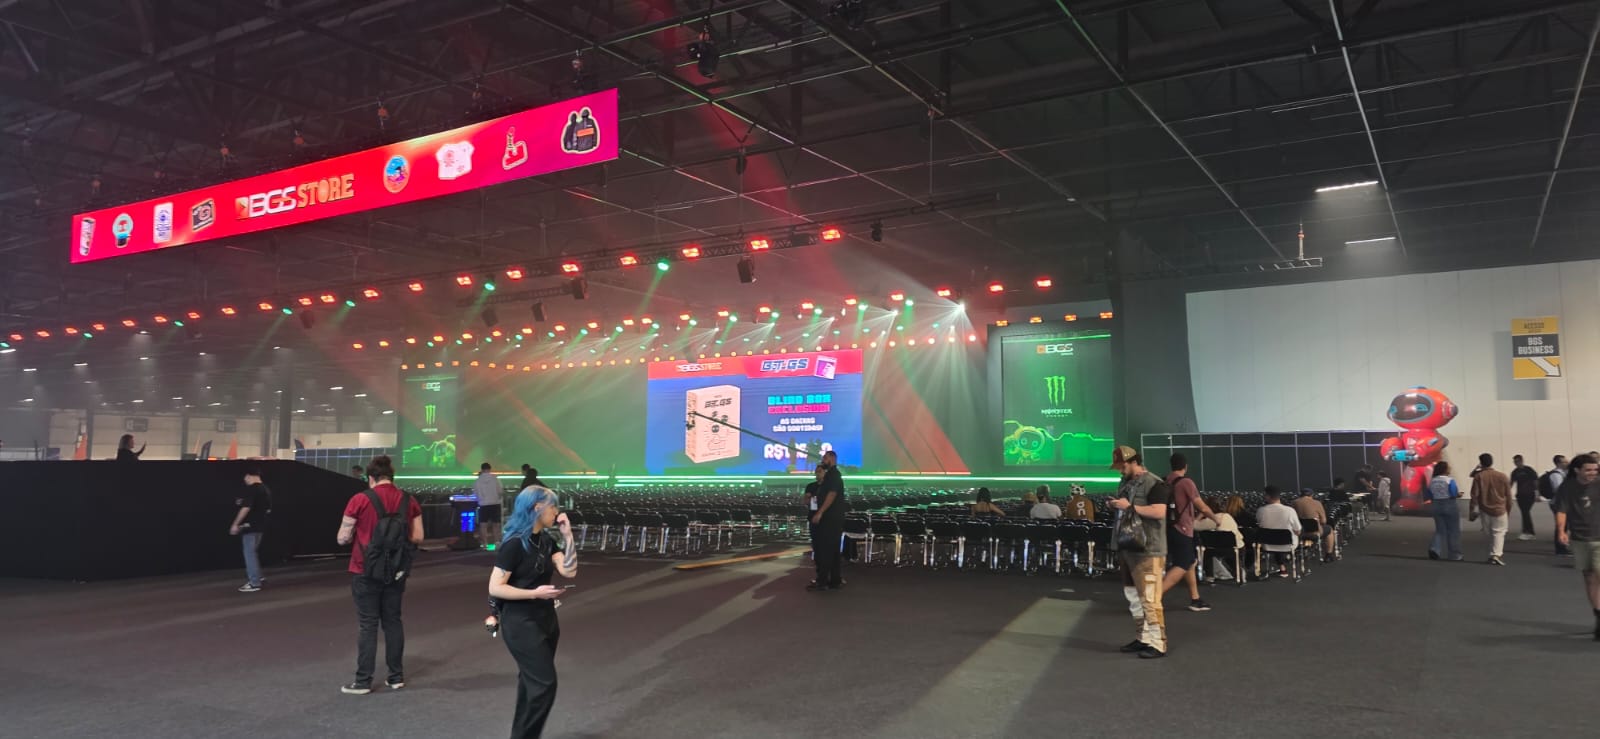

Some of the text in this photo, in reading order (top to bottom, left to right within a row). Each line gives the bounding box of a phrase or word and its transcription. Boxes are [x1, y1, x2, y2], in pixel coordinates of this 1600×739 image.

[248, 174, 354, 217] BGS STORE
[1528, 337, 1543, 345] BGS
[1046, 343, 1073, 353] BGS
[1518, 346, 1554, 354] BUSINESS
[768, 396, 803, 405] BLIND
